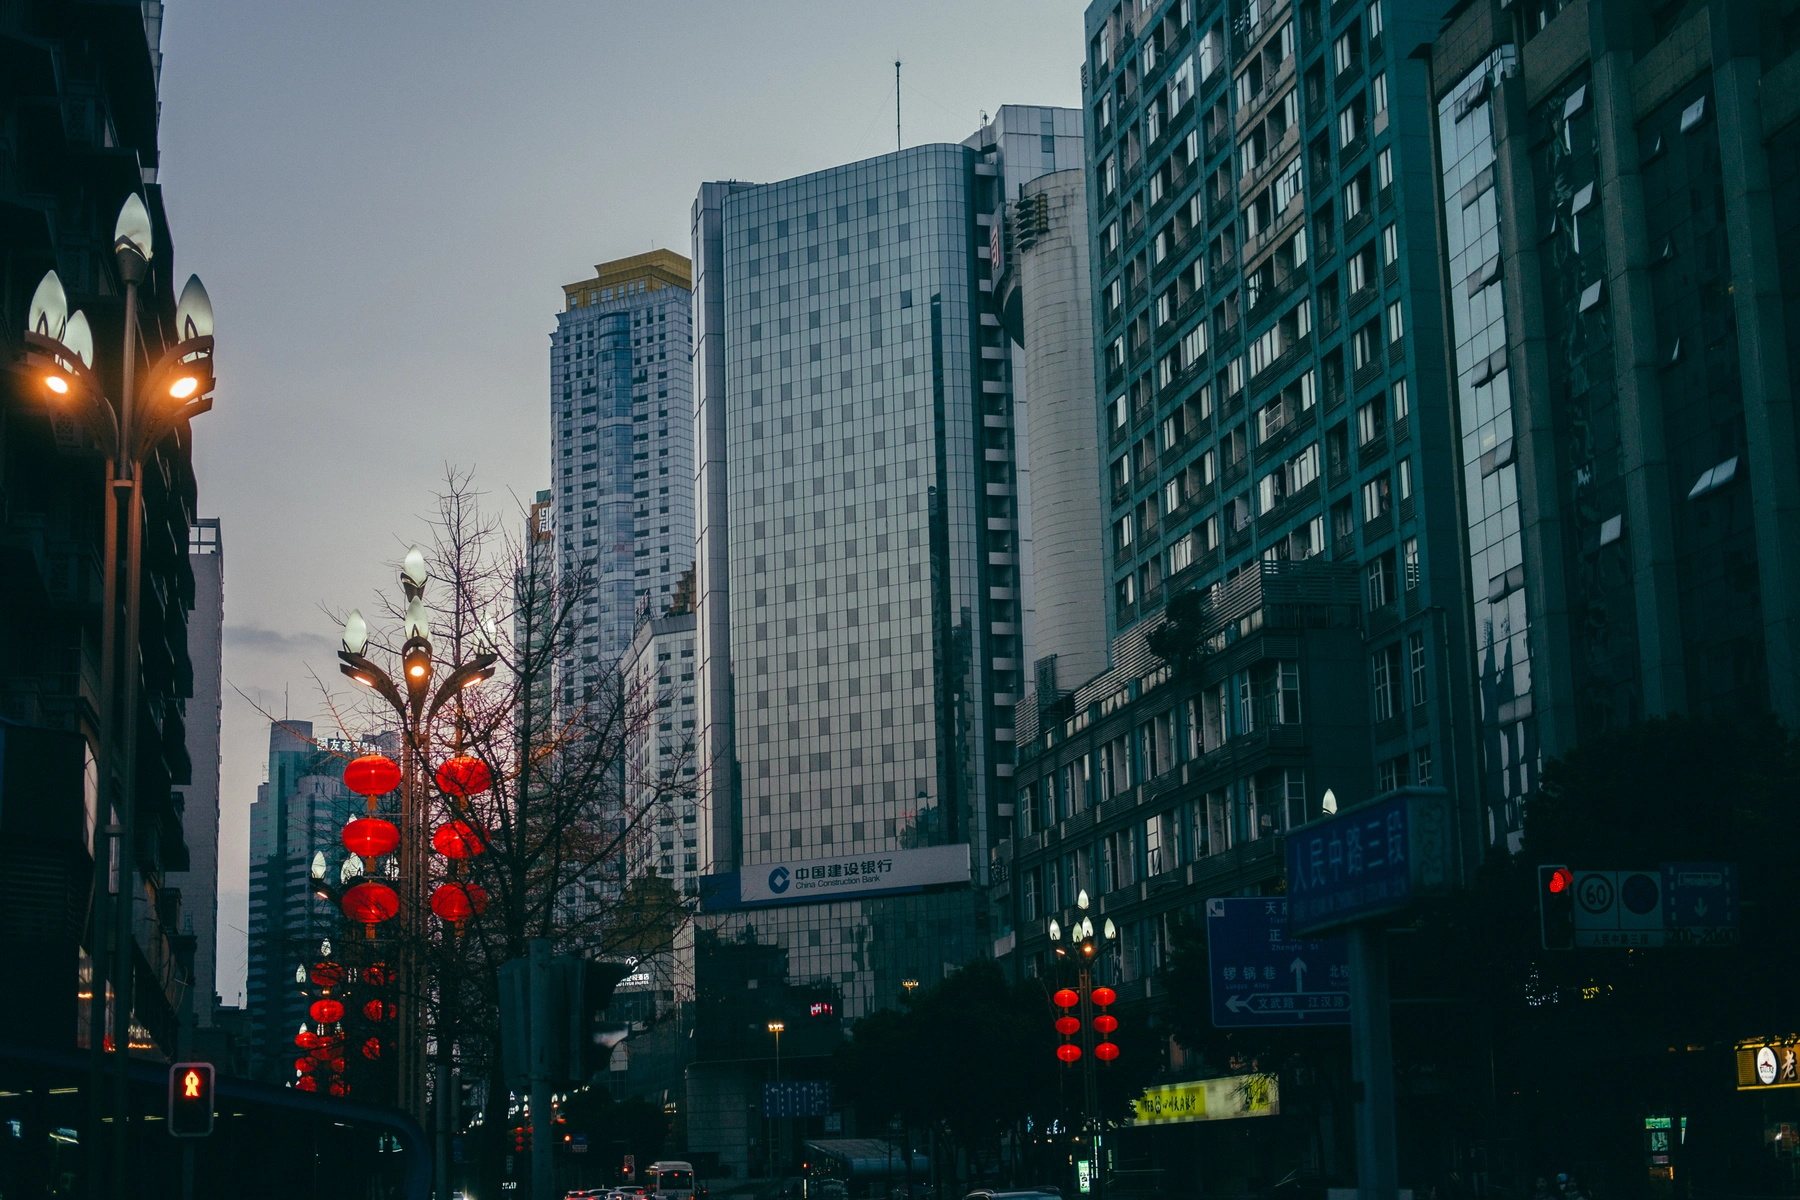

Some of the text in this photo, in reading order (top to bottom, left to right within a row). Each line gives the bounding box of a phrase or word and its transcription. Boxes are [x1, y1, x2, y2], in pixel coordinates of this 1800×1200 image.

[1293, 809, 1405, 893] 人民中路三段
[795, 859, 892, 880] 中国建设银行
[796, 874, 880, 890] China Construction Bank
[1585, 884, 1607, 905] 60
[1593, 933, 1648, 945] 人民中路三段
[1271, 944, 1302, 952] Zhengfu
[1223, 966, 1276, 981] 锣锅巷
[1258, 996, 1344, 1010] 文武路 江汉路
